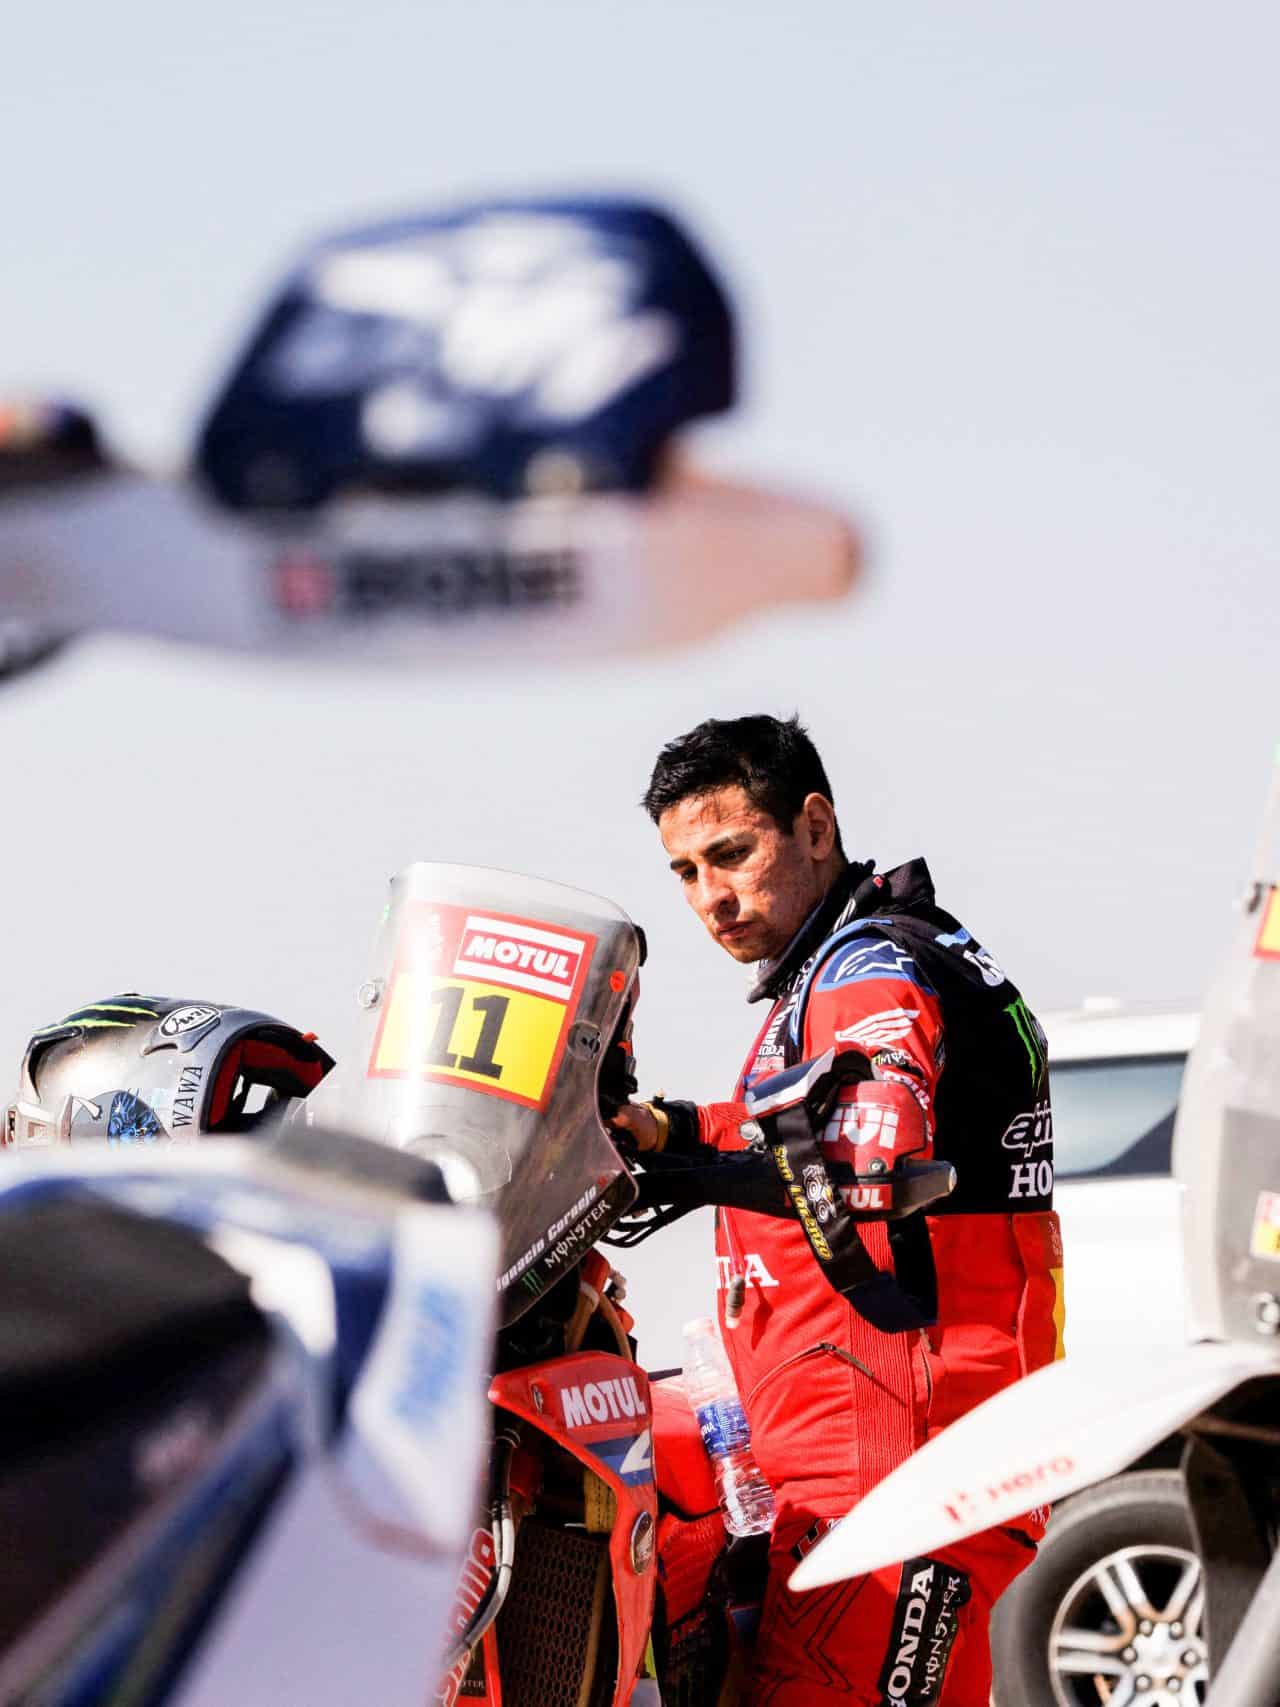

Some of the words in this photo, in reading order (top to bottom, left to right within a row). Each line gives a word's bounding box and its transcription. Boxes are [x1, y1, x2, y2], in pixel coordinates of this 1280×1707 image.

[464, 935, 570, 979] MOTUL
[423, 986, 510, 1081] 11
[172, 1066, 204, 1129] WAWA
[838, 1187, 884, 1209] TUL
[1007, 1160, 1055, 1199] HO
[544, 1200, 612, 1269] MONSTER
[547, 1186, 597, 1242] Cornejo
[561, 1376, 647, 1430] MOTUL
[920, 1576, 961, 1696] MONSTER
